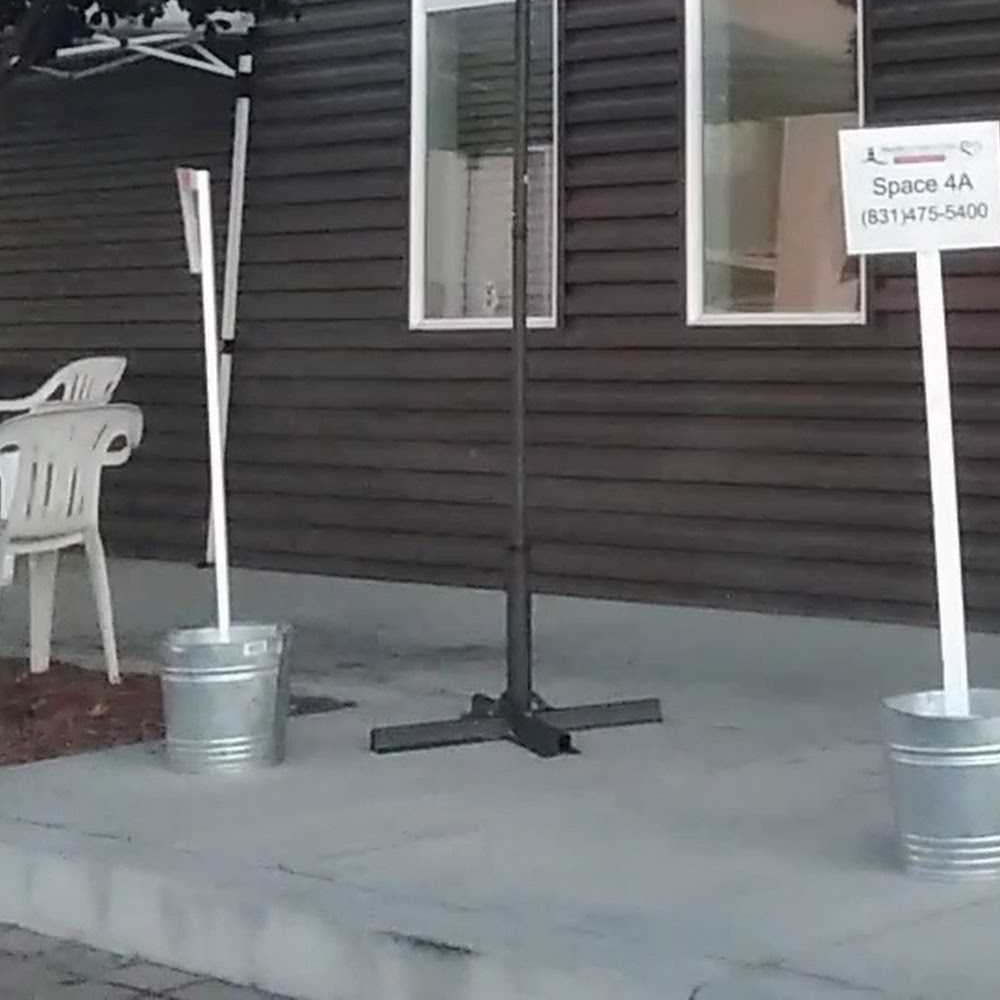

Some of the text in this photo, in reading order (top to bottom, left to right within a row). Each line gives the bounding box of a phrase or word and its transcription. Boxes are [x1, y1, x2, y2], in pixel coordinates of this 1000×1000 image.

[872, 172, 974, 199] Space 4A
[860, 202, 989, 228] (831)475-5400
